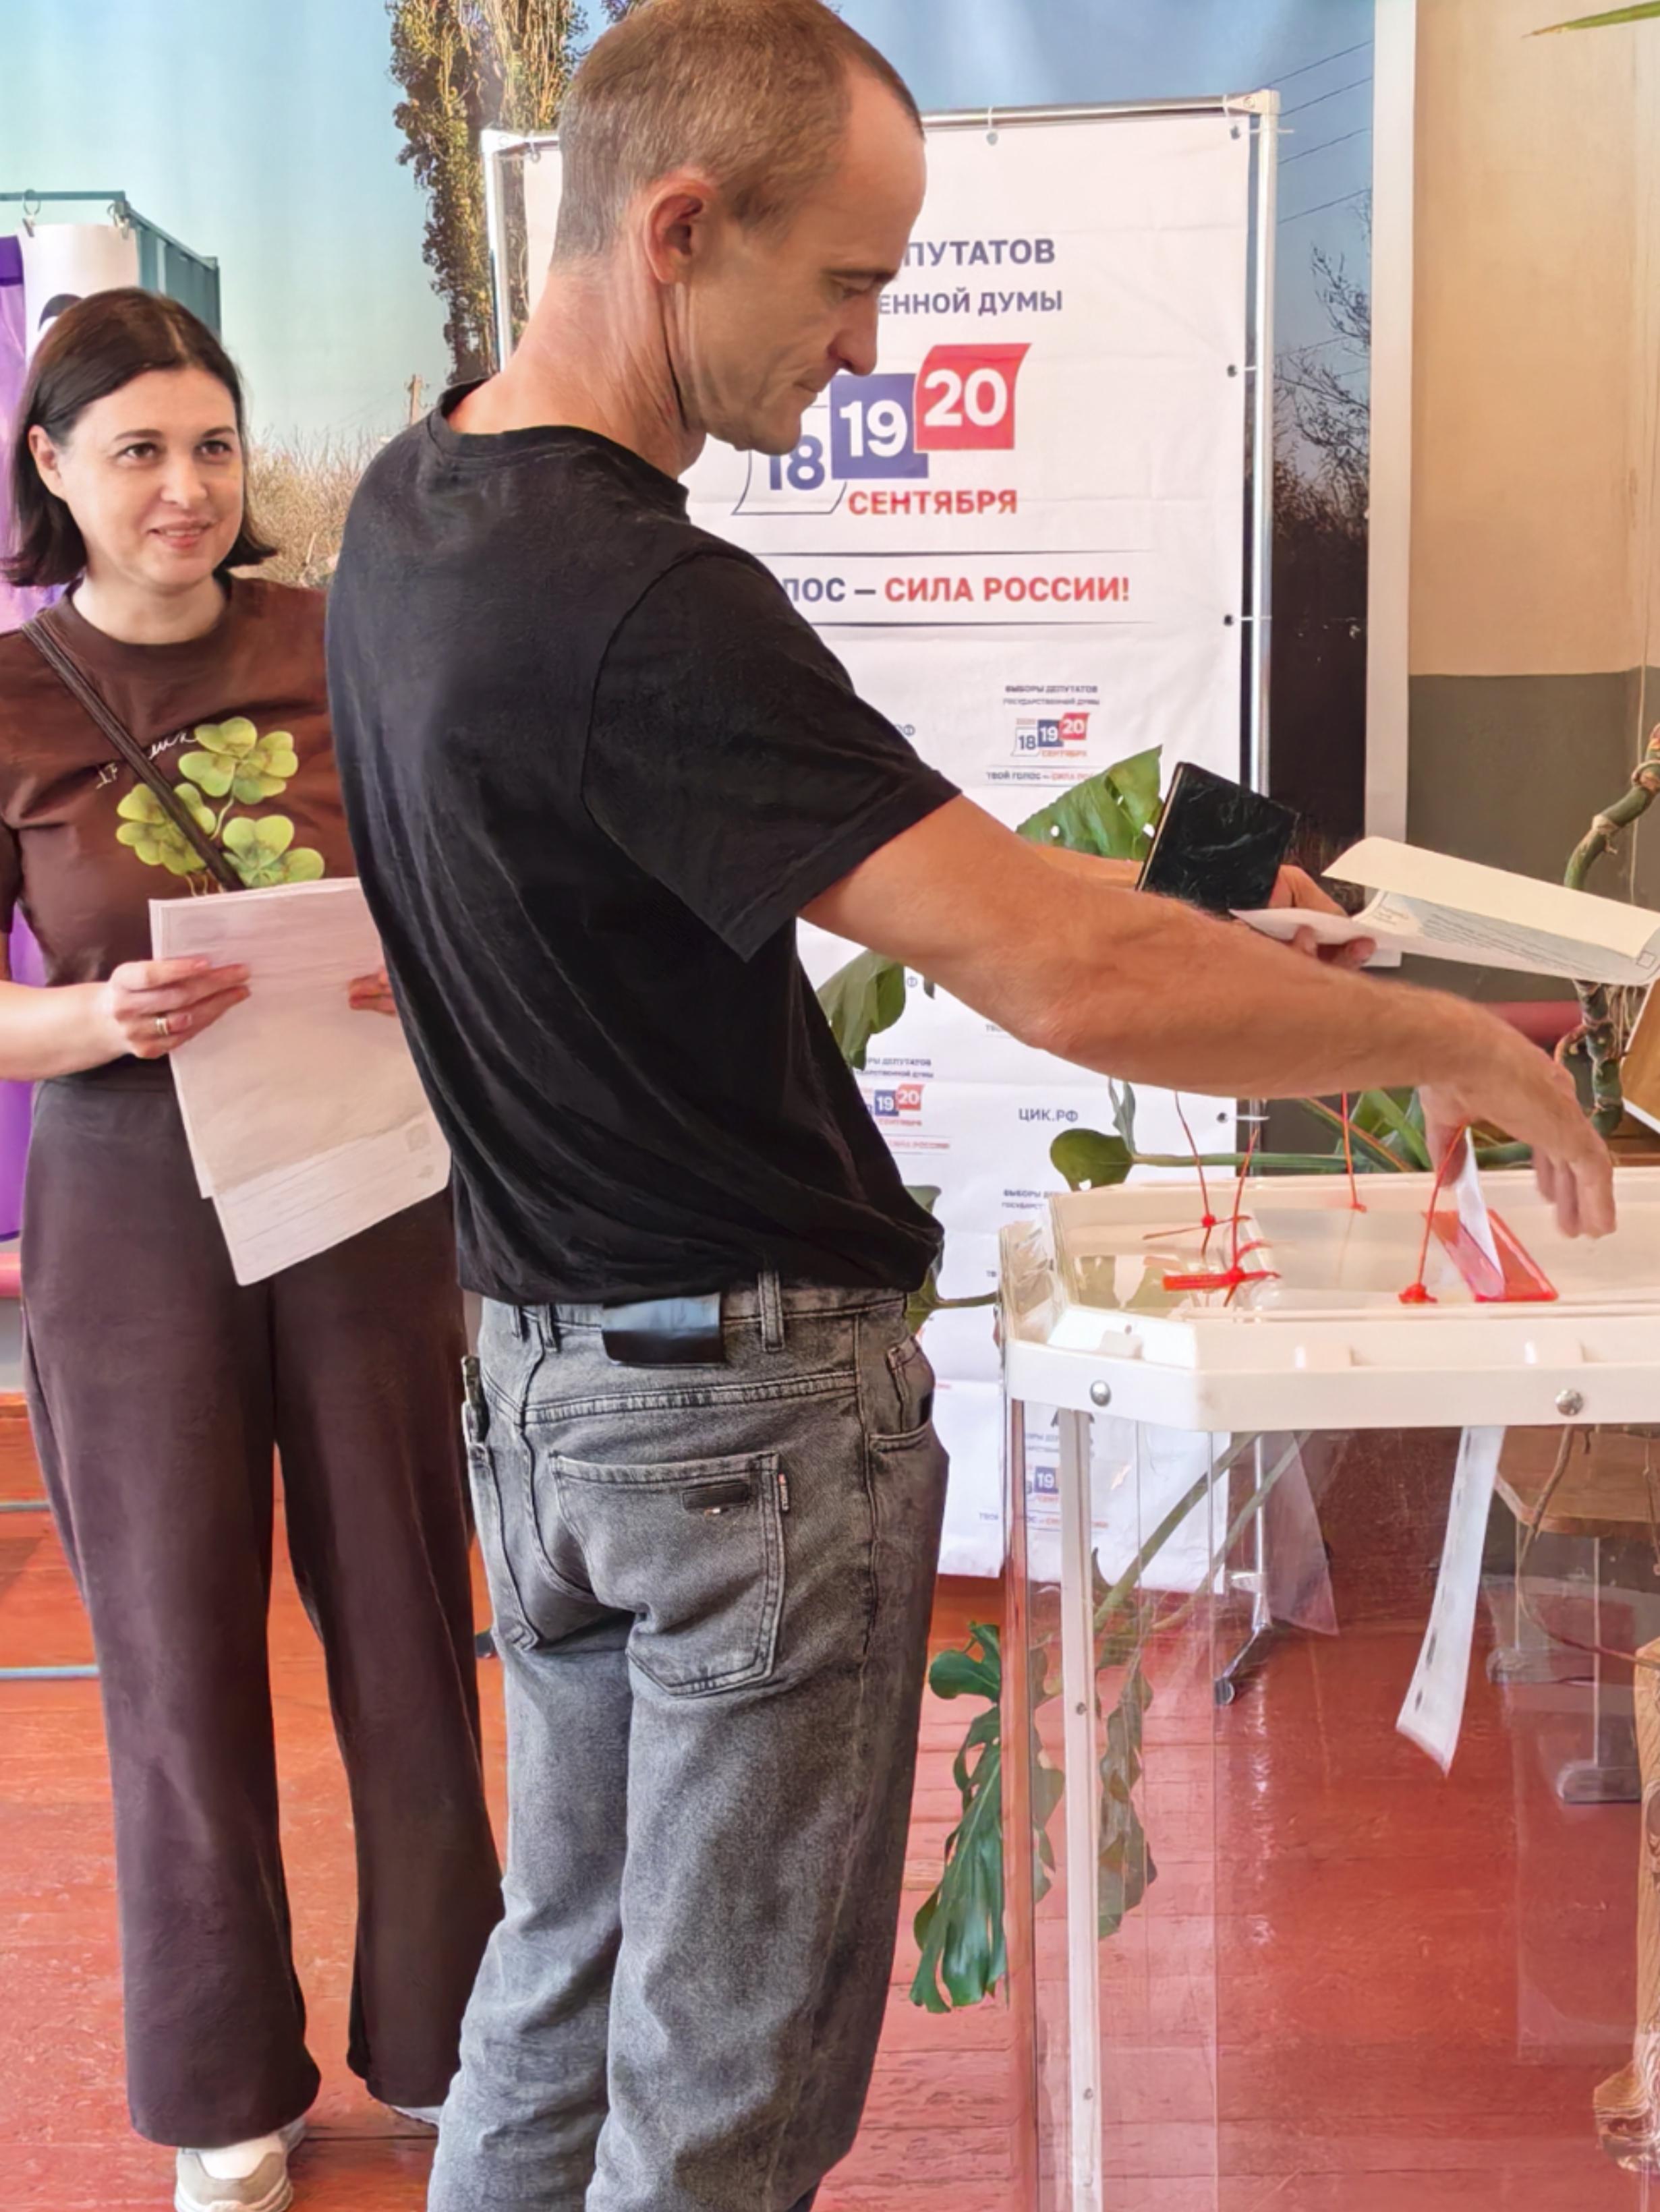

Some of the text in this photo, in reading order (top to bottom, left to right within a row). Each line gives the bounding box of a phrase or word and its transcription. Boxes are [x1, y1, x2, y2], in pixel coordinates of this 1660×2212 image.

[904, 238, 1056, 267] ПУТАТОВ
[879, 287, 1062, 317] ЕННОЙ ДУМЫ
[770, 368, 1008, 491] 18 19 20
[848, 490, 1018, 515] СЕНТЯБРЯ
[782, 577, 846, 602] ЛОС
[884, 577, 974, 602] СИЛА
[983, 577, 1130, 602] РОССИИ!
[1018, 719, 1085, 751] 18 19 20
[877, 1096, 894, 1111] 19
[898, 1090, 920, 1105] 20
[1019, 1108, 1078, 1122] ЦИК.РФ
[1037, 1473, 1054, 1488] 19
